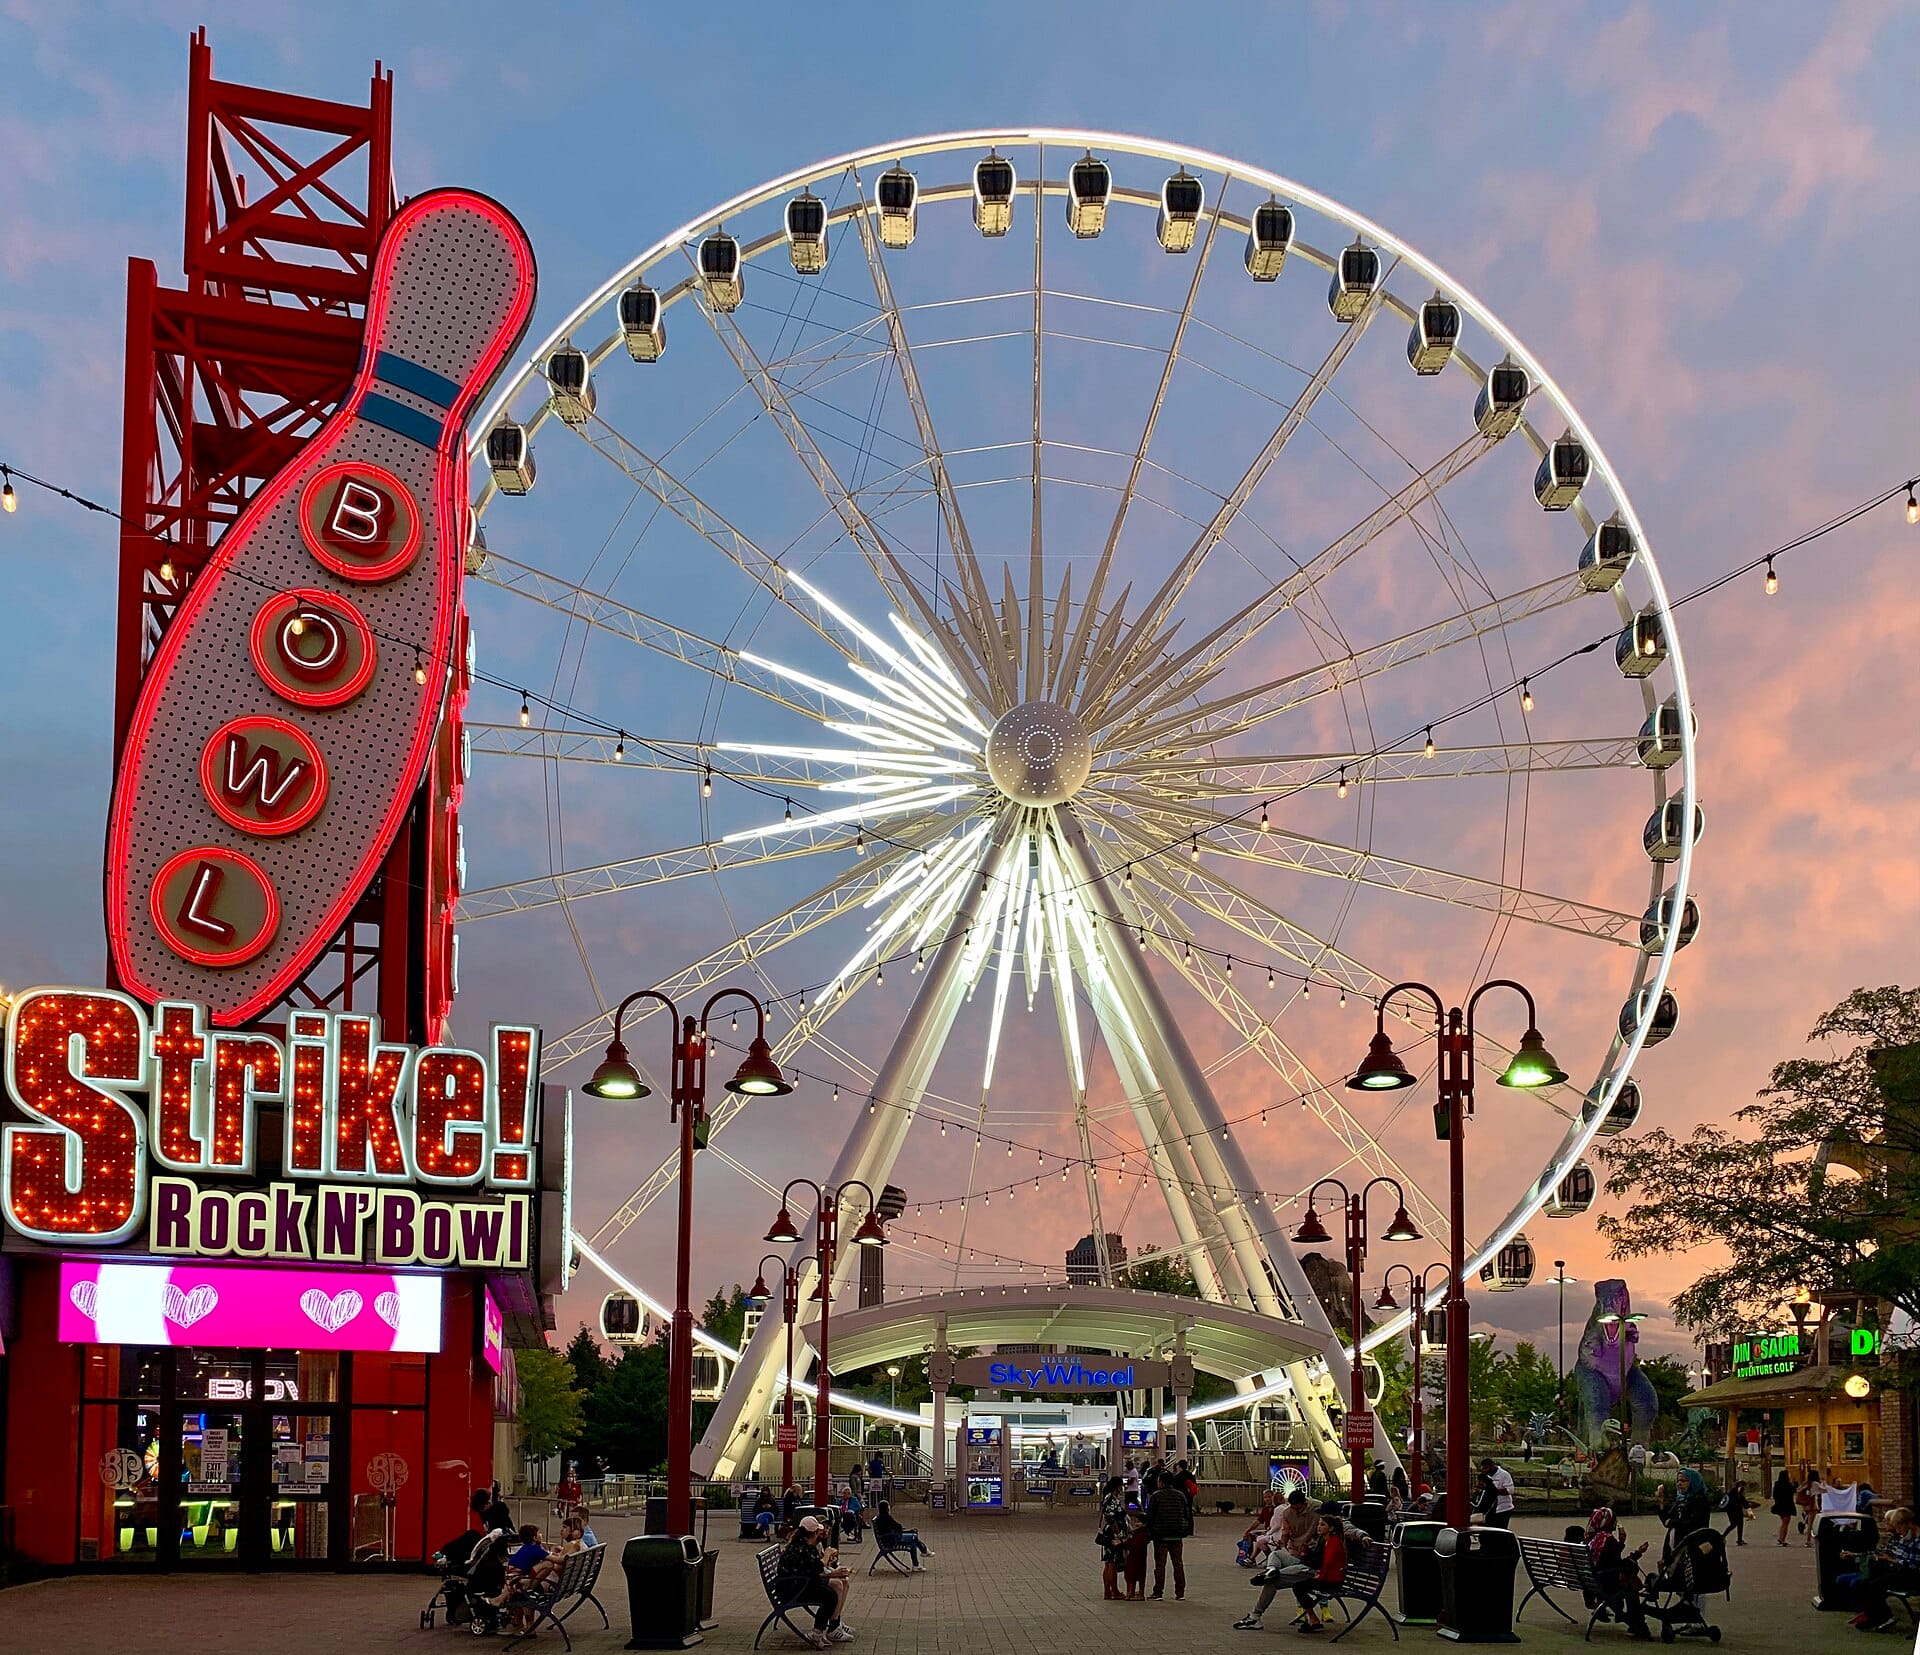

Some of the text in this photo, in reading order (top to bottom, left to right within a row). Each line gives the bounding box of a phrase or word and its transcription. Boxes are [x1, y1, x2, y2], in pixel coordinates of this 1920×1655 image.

[176, 474, 396, 943] BOWL
[3, 988, 537, 1245] Strike!
[152, 1178, 310, 1256] Rock
[989, 1363, 1134, 1389] SkyWheel
[1737, 1361, 1795, 1378] ADVENTURE GOLF
[205, 1471, 223, 1480] ONLY
[206, 1463, 221, 1471] EXIT
